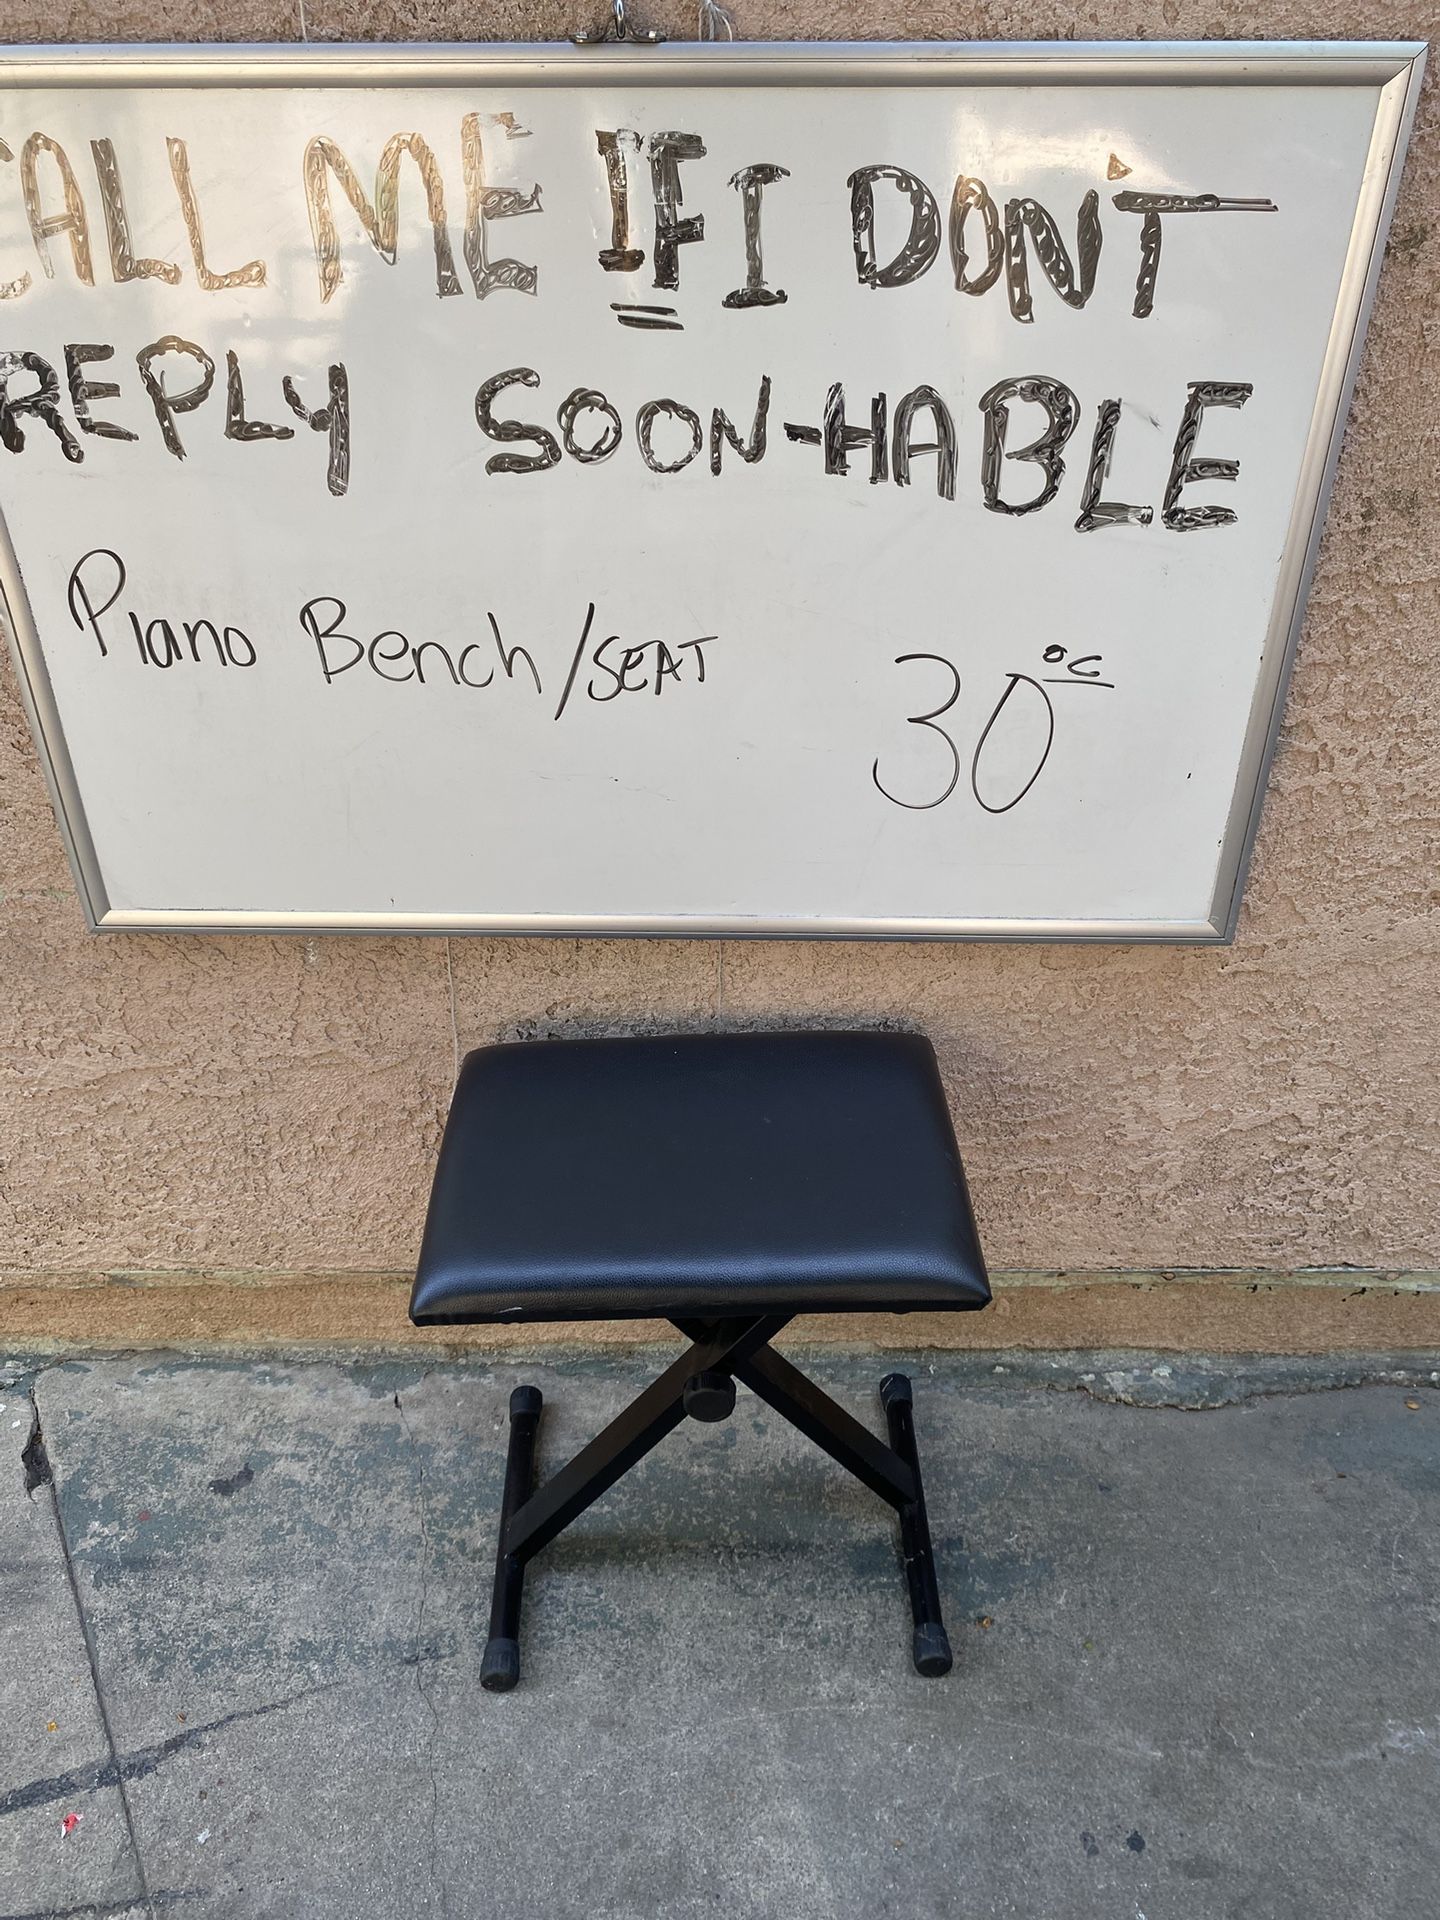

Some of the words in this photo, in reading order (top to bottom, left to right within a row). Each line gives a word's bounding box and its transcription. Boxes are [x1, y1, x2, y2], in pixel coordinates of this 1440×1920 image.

[302, 111, 543, 304] ME
[595, 129, 707, 291] IF
[721, 162, 791, 309] I
[0, 334, 351, 497] REPLY
